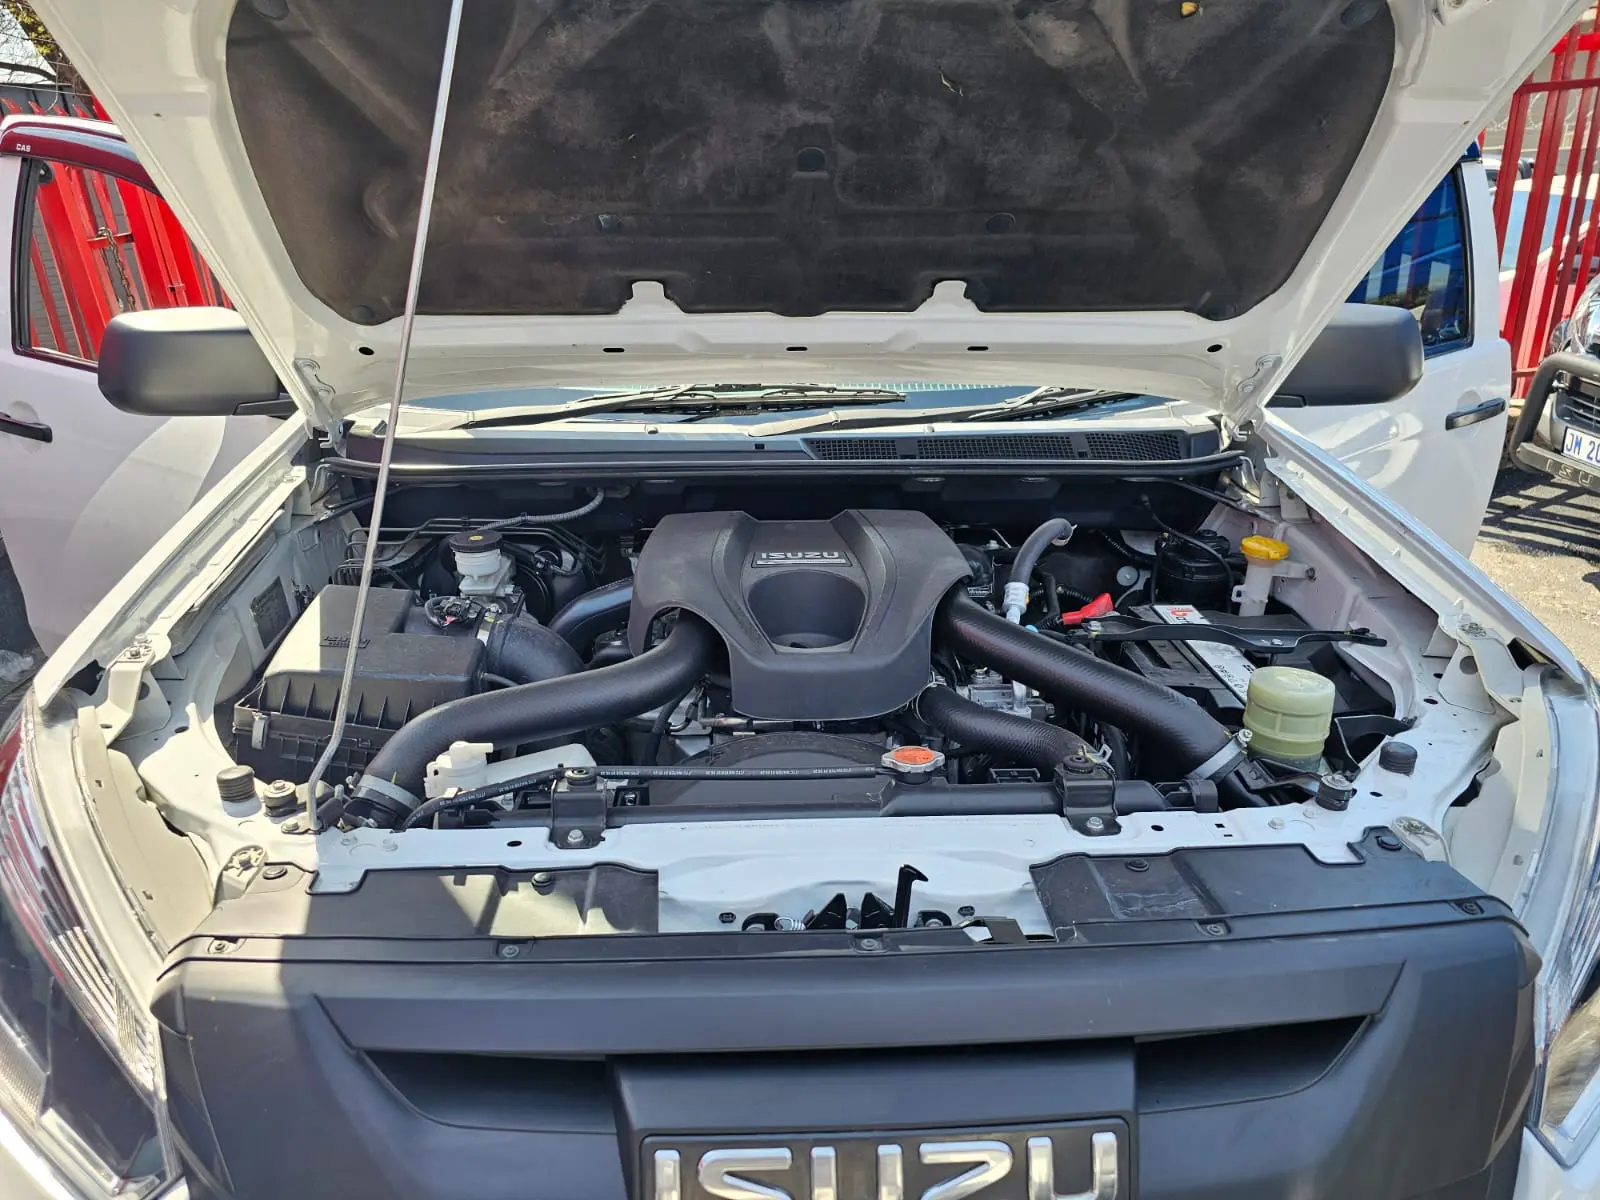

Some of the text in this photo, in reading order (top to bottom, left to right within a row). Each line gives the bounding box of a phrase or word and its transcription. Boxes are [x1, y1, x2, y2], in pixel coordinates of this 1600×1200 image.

[1566, 433, 1582, 456] JM
[761, 551, 839, 559] ISUZU
[654, 1131, 1119, 1200] ISUZU
